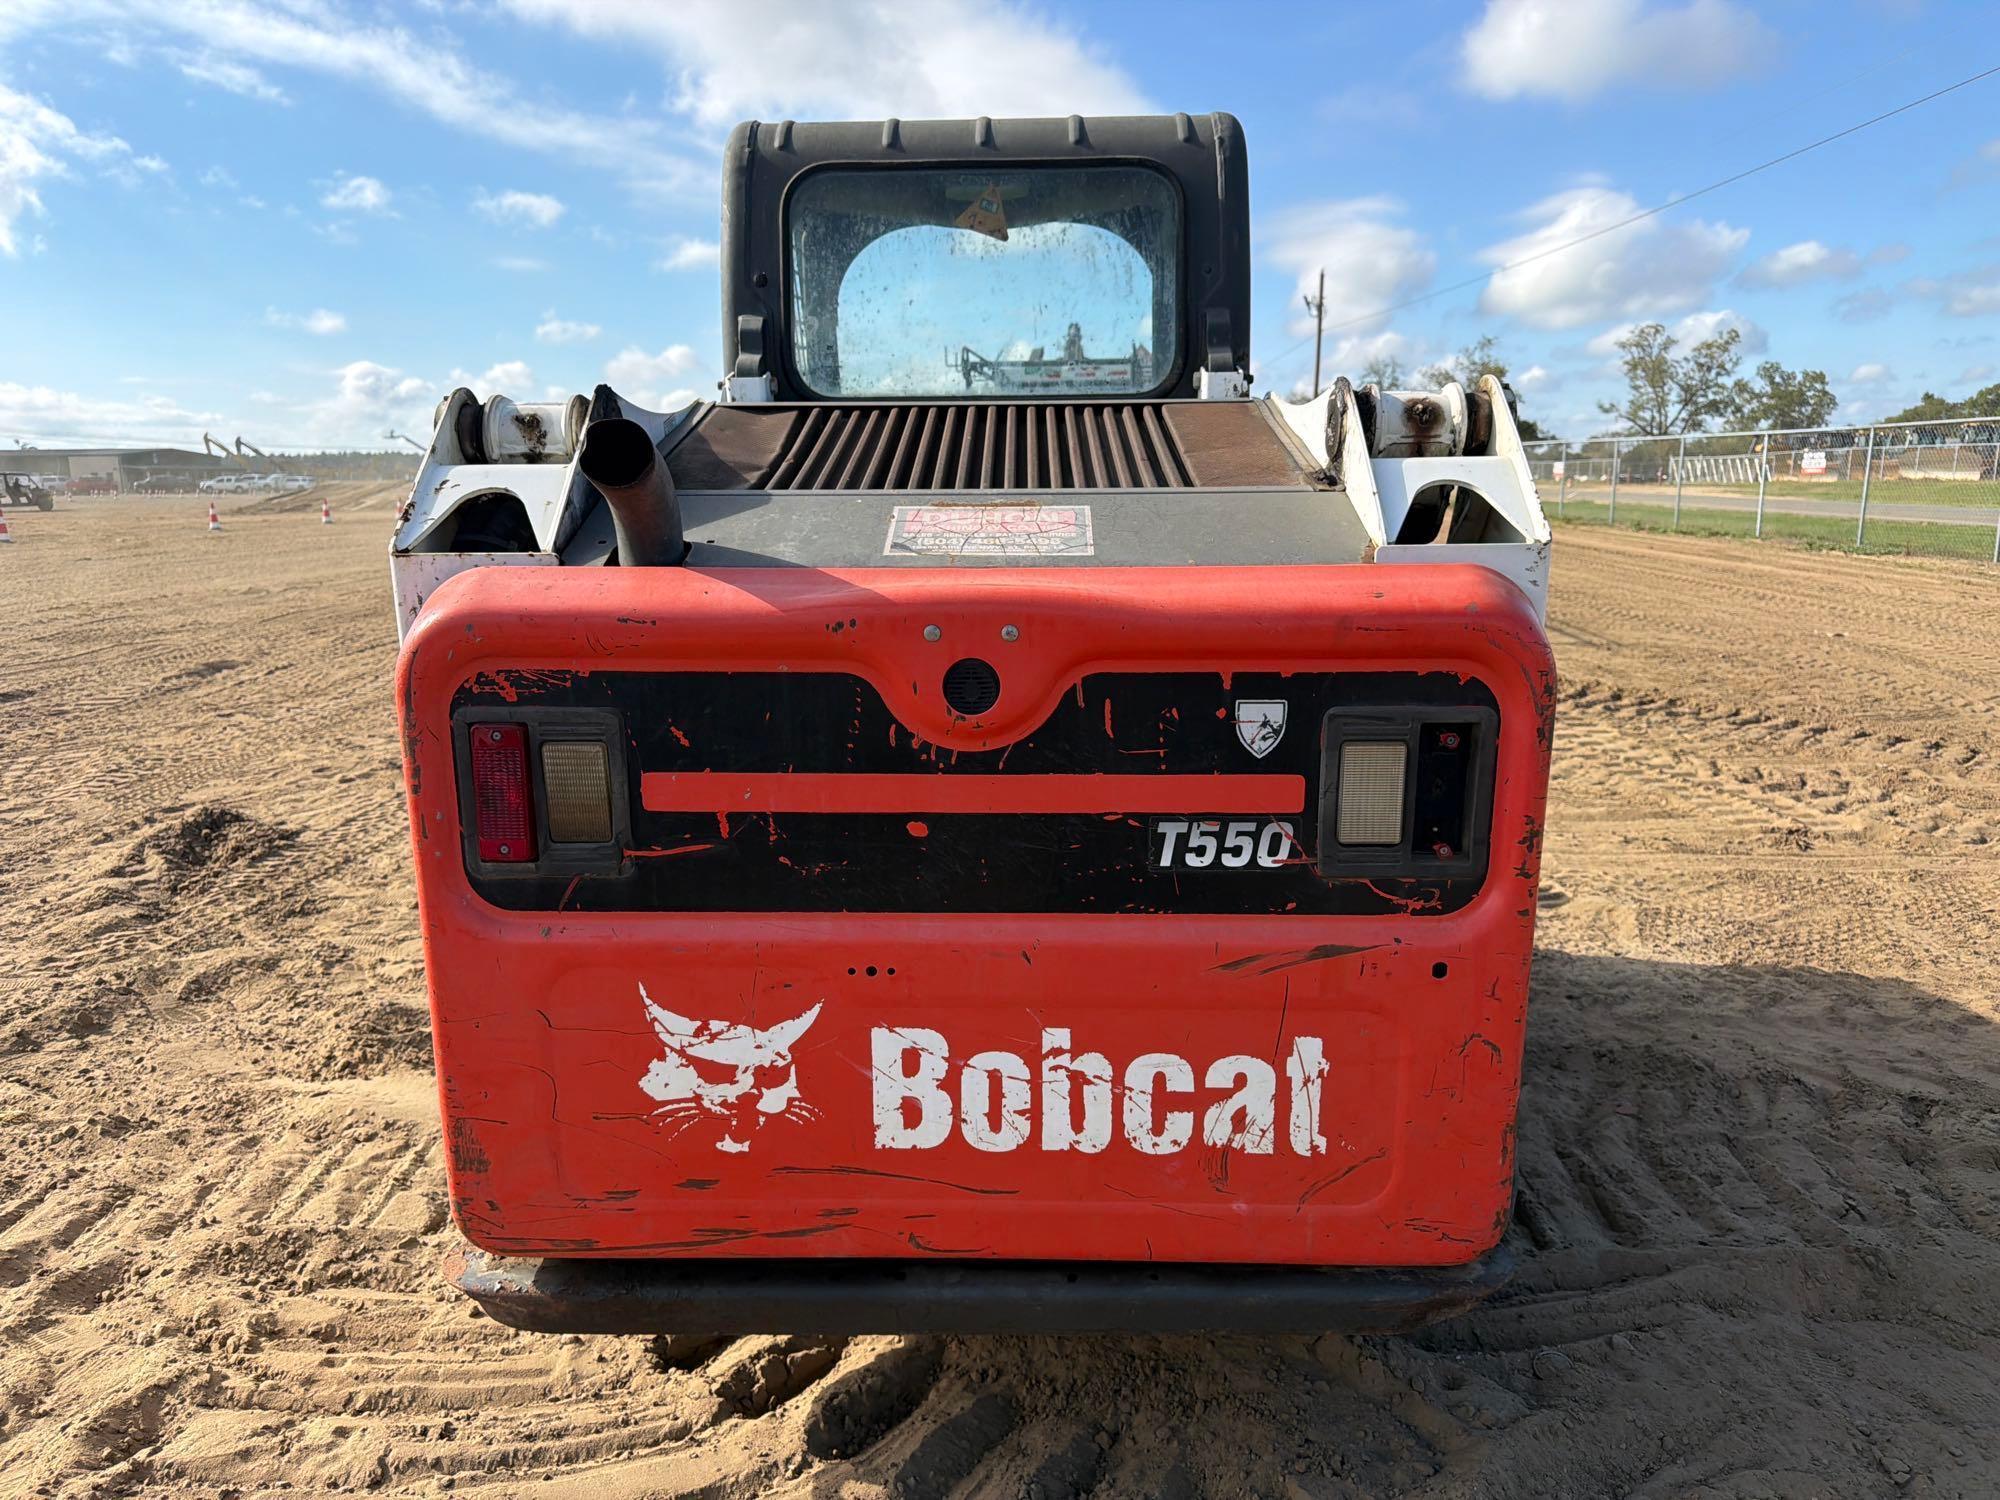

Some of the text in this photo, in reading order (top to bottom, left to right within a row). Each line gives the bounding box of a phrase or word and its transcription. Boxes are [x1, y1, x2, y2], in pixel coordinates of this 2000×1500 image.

[917, 537, 964, 546] (504)
[1157, 821, 1294, 868] T550
[870, 1027, 1330, 1157] Bobcat
